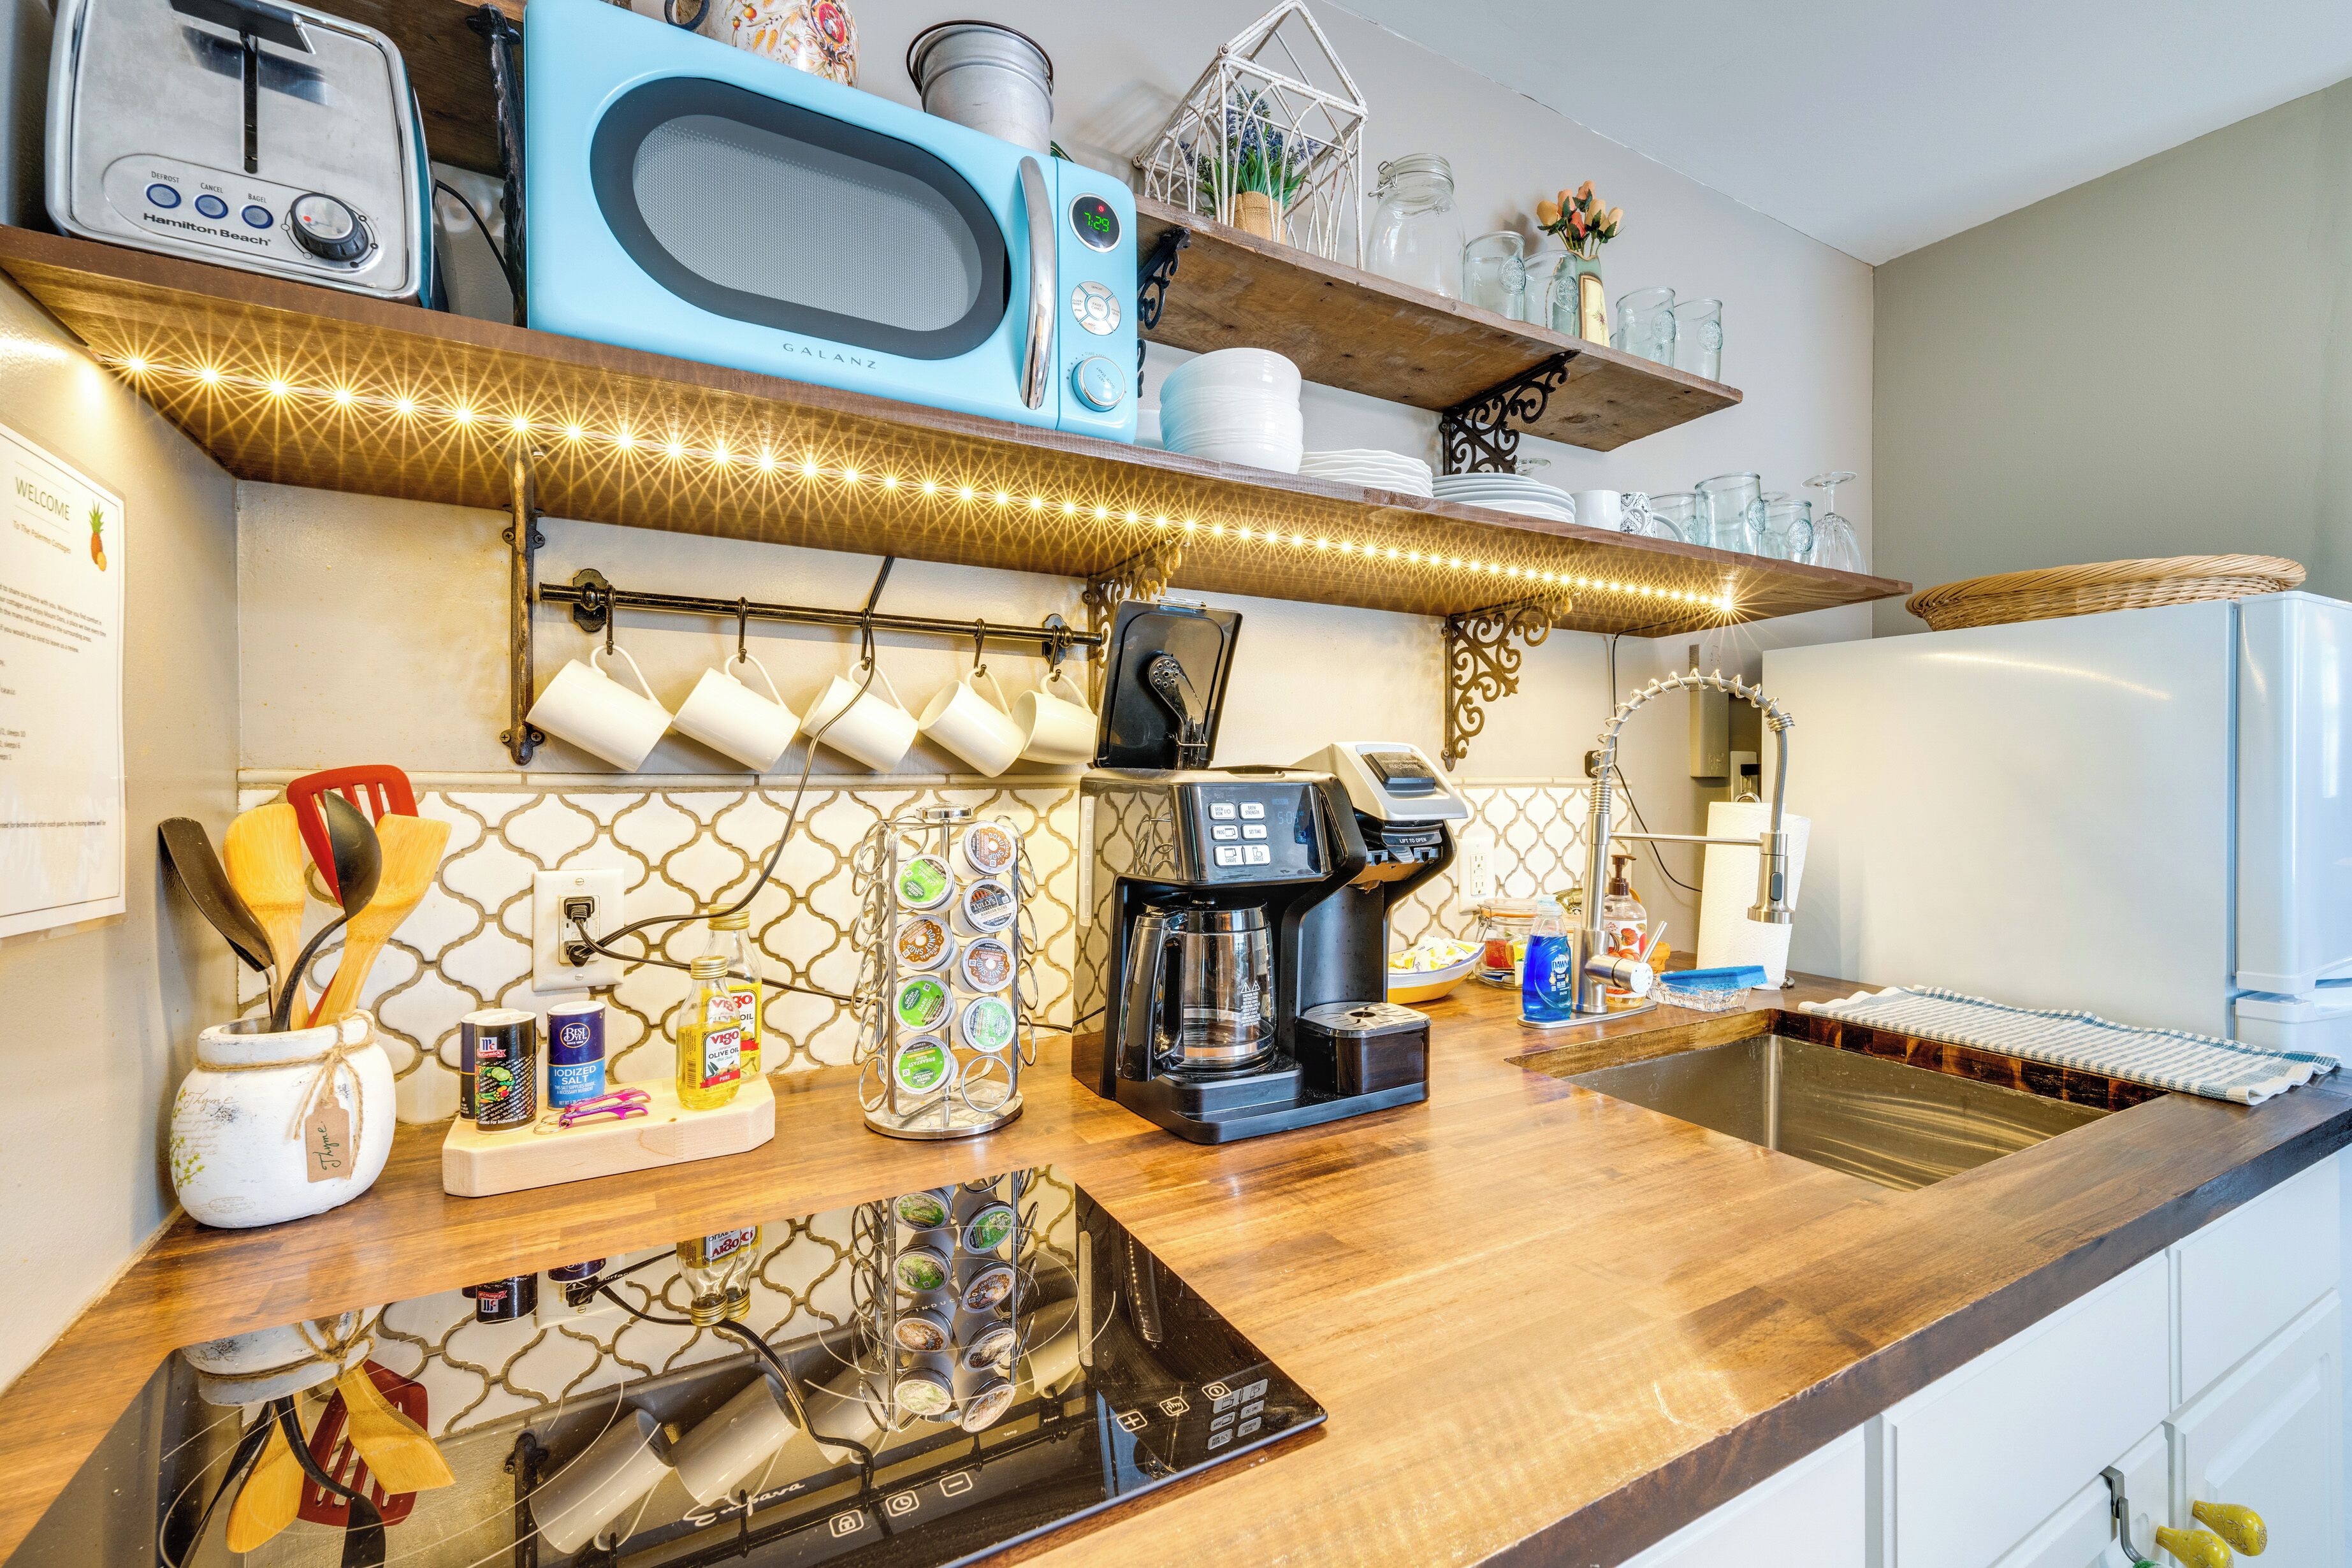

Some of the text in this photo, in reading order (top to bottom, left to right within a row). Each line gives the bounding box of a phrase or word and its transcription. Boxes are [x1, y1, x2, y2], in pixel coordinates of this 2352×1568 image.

[151, 171, 180, 184] DEFROST
[201, 182, 224, 194] CANCEL
[248, 193, 266, 203] BAGEL
[143, 213, 268, 246] Hamilton Beach
[1084, 212, 1109, 233] 7:29
[783, 343, 876, 369] GALANZ
[15, 476, 69, 521] WELCOME
[989, 832, 1005, 859] DONUT SHOP
[906, 882, 924, 896] MOUNTAIN
[907, 886, 918, 896] GREEN
[907, 929, 936, 955] DONUT SHOP
[920, 945, 939, 959] ORIGINAL
[976, 958, 1004, 978] DONUT SHOP
[1551, 960, 1569, 969] DAWN
[905, 991, 914, 1005] GREEN
[906, 990, 919, 1010] MOUNTAIN
[918, 997, 928, 1011] DARK
[922, 997, 933, 1015] MAGIC
[563, 1027, 586, 1042] BEST
[709, 1050, 729, 1059] OLIVE
[908, 1057, 936, 1067] BREAKFAST
[555, 1065, 597, 1077] IODIZED
[913, 1071, 933, 1080] MOUNTAIN
[514, 1080, 527, 1089] BLACK
[562, 1075, 588, 1085] SALT
[509, 1086, 525, 1097] PEPPER
[184, 1089, 238, 1112] Thyme
[491, 1102, 507, 1112] PEPPER
[509, 1093, 522, 1103] BLACK
[503, 1100, 519, 1110] PEPPER
[502, 1107, 516, 1115] BLACK
[516, 1104, 528, 1113] BLACK
[312, 1121, 342, 1168] Thyme
[1043, 1415, 1059, 1423] Power
